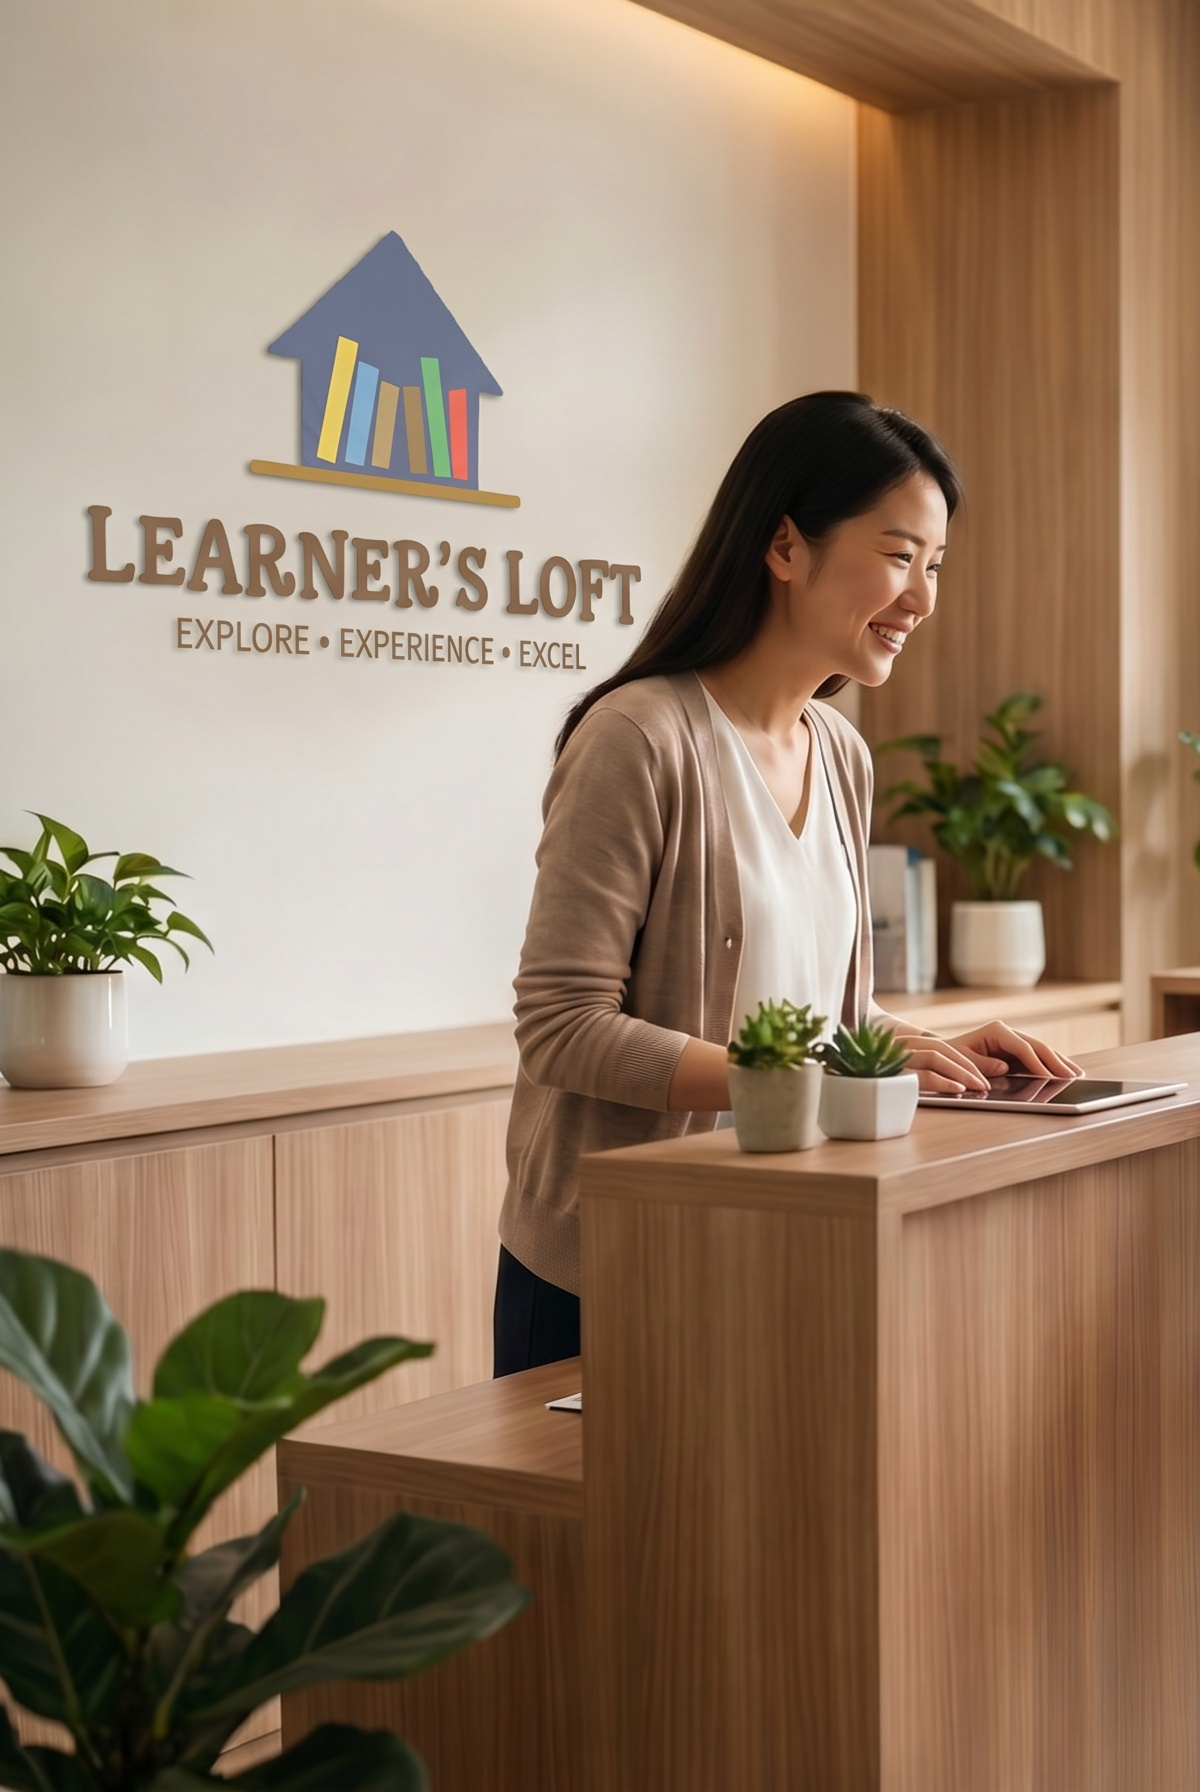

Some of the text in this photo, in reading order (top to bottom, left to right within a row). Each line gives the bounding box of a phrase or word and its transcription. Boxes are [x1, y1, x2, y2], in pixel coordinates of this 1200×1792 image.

[87, 504, 642, 625] LEARNER'S LOFT
[176, 617, 587, 670] EXPLORE EXPERIENCE EXCEL
